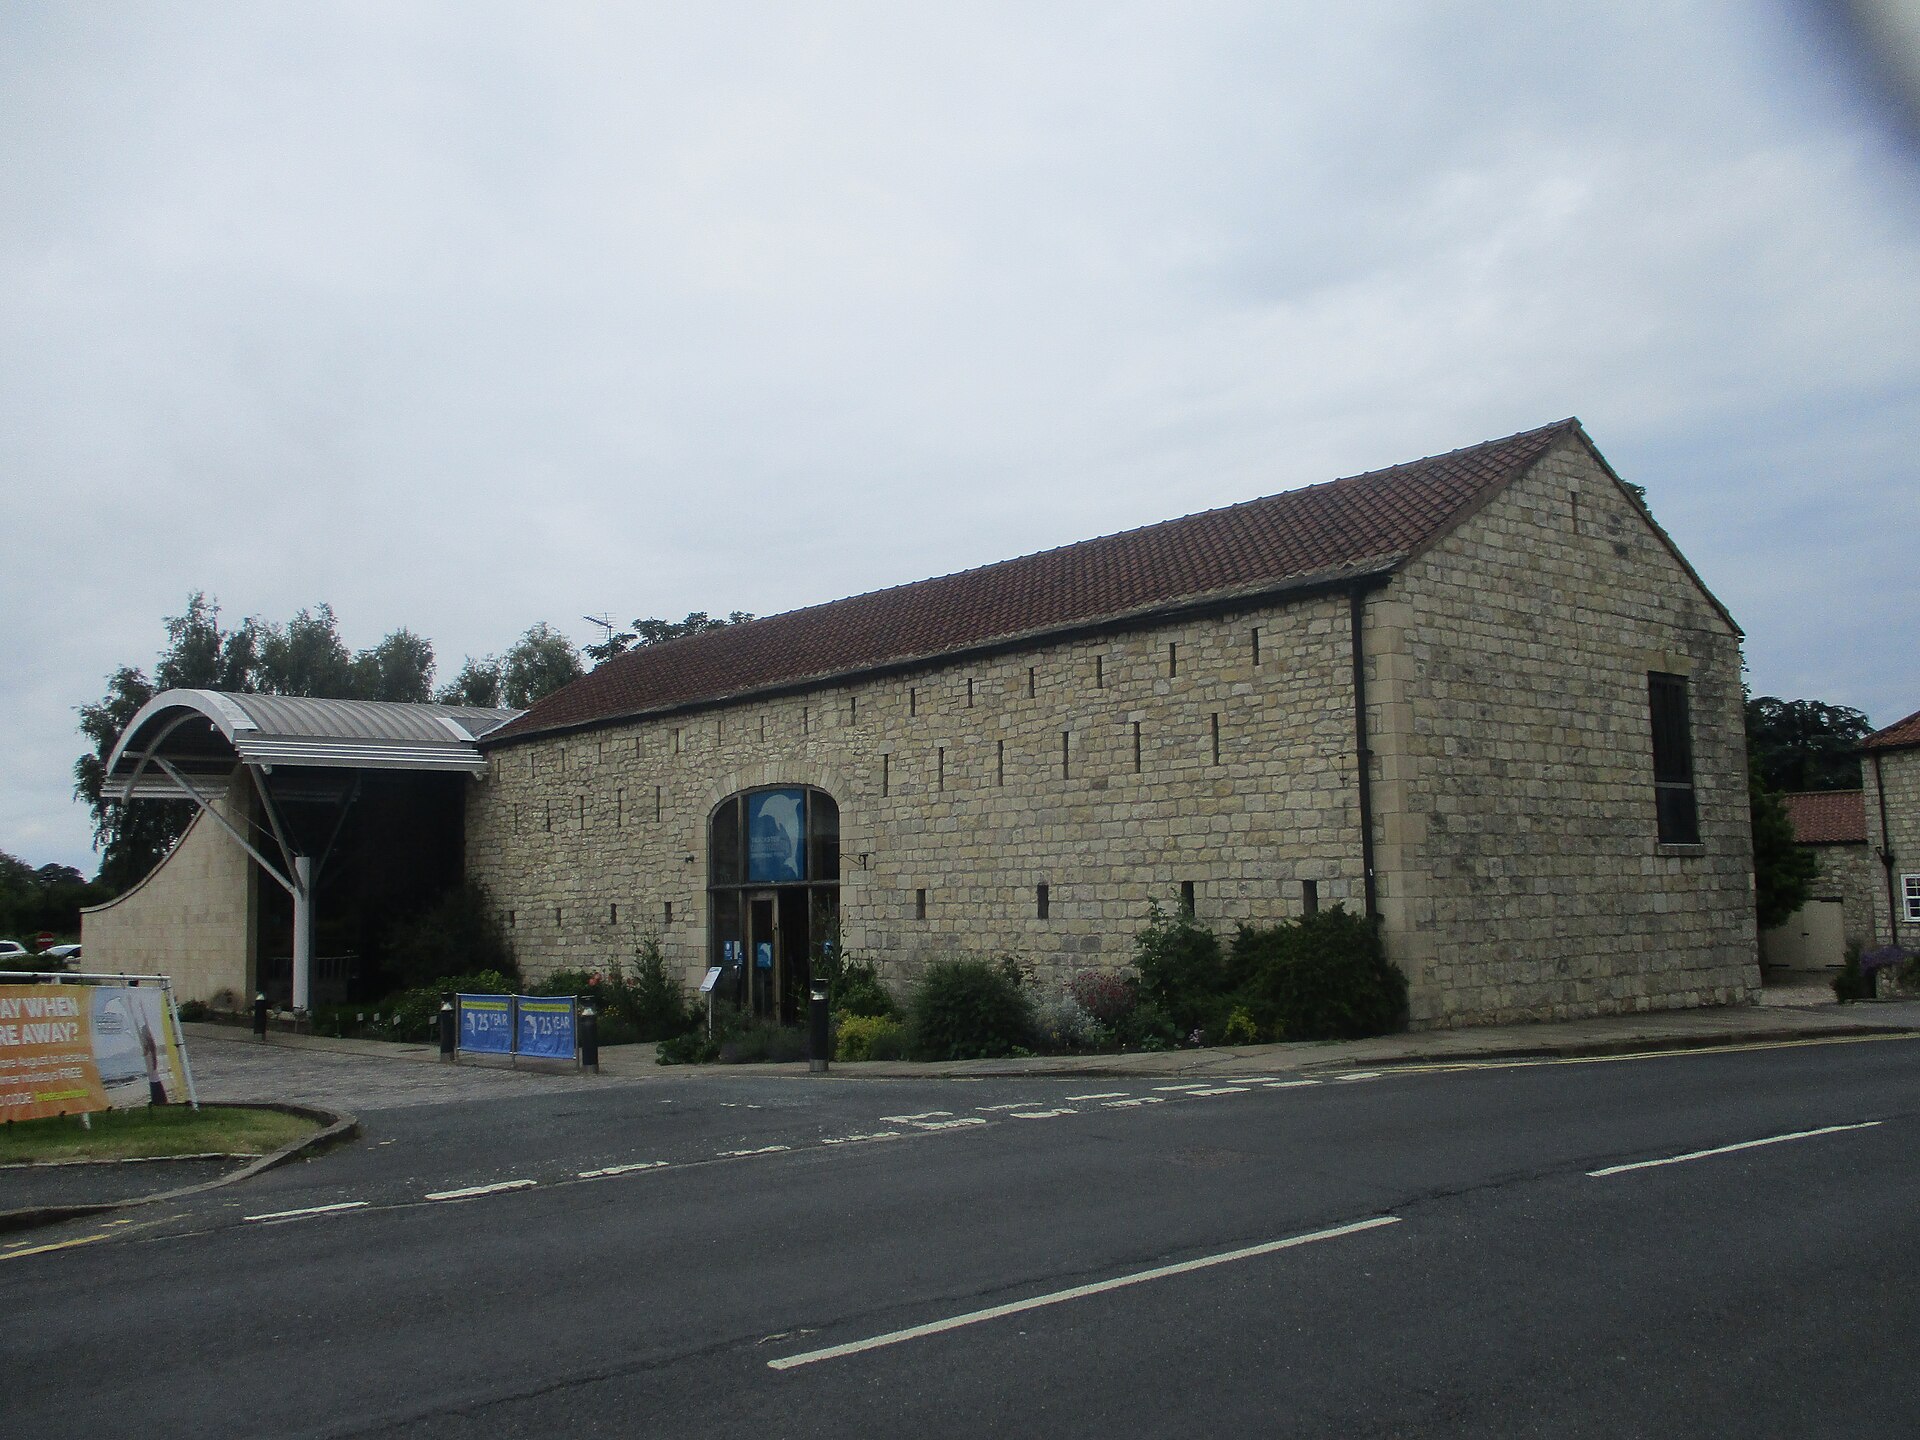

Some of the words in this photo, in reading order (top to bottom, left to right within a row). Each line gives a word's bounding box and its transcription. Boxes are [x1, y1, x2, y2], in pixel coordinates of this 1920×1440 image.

[22, 997, 80, 1017] WHEN
[477, 1013, 489, 1031] 25
[489, 1013, 508, 1026] YEAR
[538, 1016, 552, 1035] 25
[552, 1016, 571, 1029] YEAR
[22, 1022, 79, 1044] AWAY?
